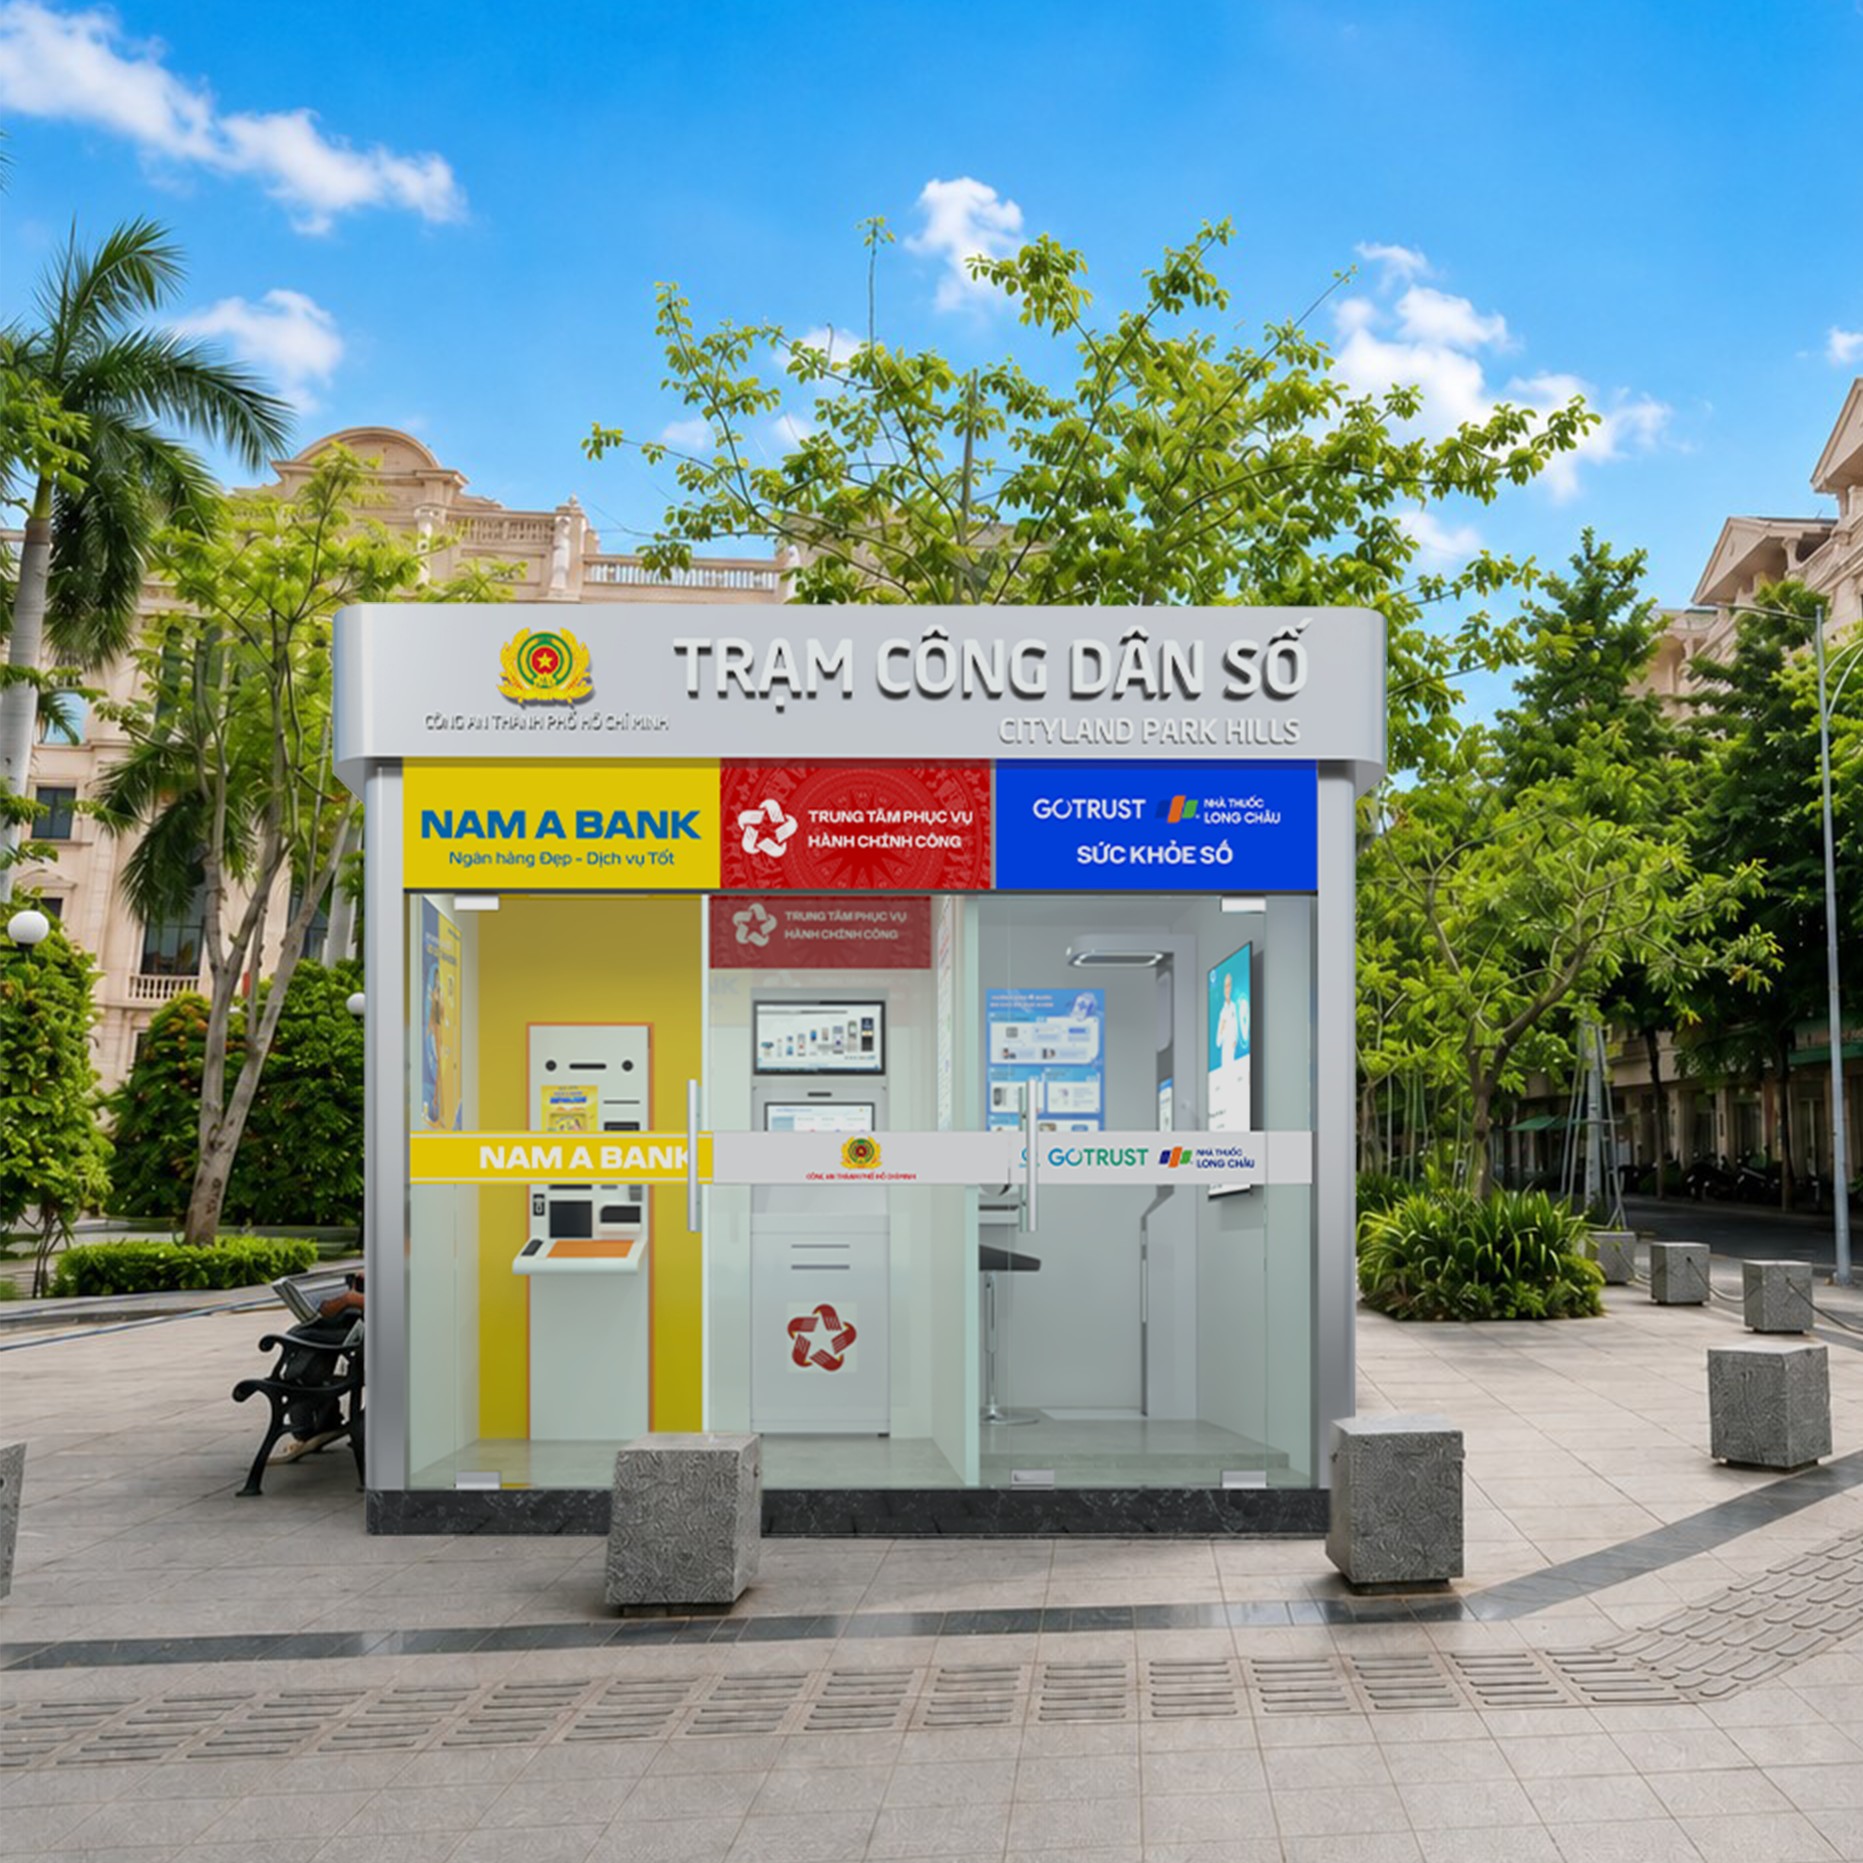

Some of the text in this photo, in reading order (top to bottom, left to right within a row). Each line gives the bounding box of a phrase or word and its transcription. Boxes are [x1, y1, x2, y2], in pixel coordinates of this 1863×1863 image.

[673, 617, 1314, 714] TRẠM CÔNG DÂN SỐ
[424, 711, 464, 731] CÔNG
[467, 715, 489, 730] AN
[632, 715, 670, 731] MINH
[1000, 717, 1301, 745] CITYLAND PARK HILLS
[1033, 798, 1146, 819] GOTRUST
[1204, 795, 1264, 808] NHÀ THUỐC
[421, 810, 702, 839] NAM A BANK
[808, 808, 973, 825] TRUNG TÂM PHỤC VỤ
[1204, 810, 1281, 824] LONG CHÂU
[808, 832, 962, 848] HÀNH CHÍNH CÔNG
[449, 851, 492, 867] Ngân
[496, 851, 535, 867] hàng
[539, 851, 572, 867] Đẹp
[587, 851, 621, 867] Dịch
[625, 854, 645, 867] vụ
[647, 849, 675, 865] Tốt
[1077, 839, 1233, 864] SỨC KHỎE SỐ
[785, 911, 826, 922] TRUNG
[854, 911, 888, 924] PHỤC
[889, 911, 907, 924] VỤ
[785, 927, 820, 939] HÀNH
[863, 927, 898, 939] CÔNG
[479, 1146, 689, 1169] NAM A BANK
[1048, 1148, 1149, 1166] GOTRUST
[1196, 1159, 1225, 1168] LONG
